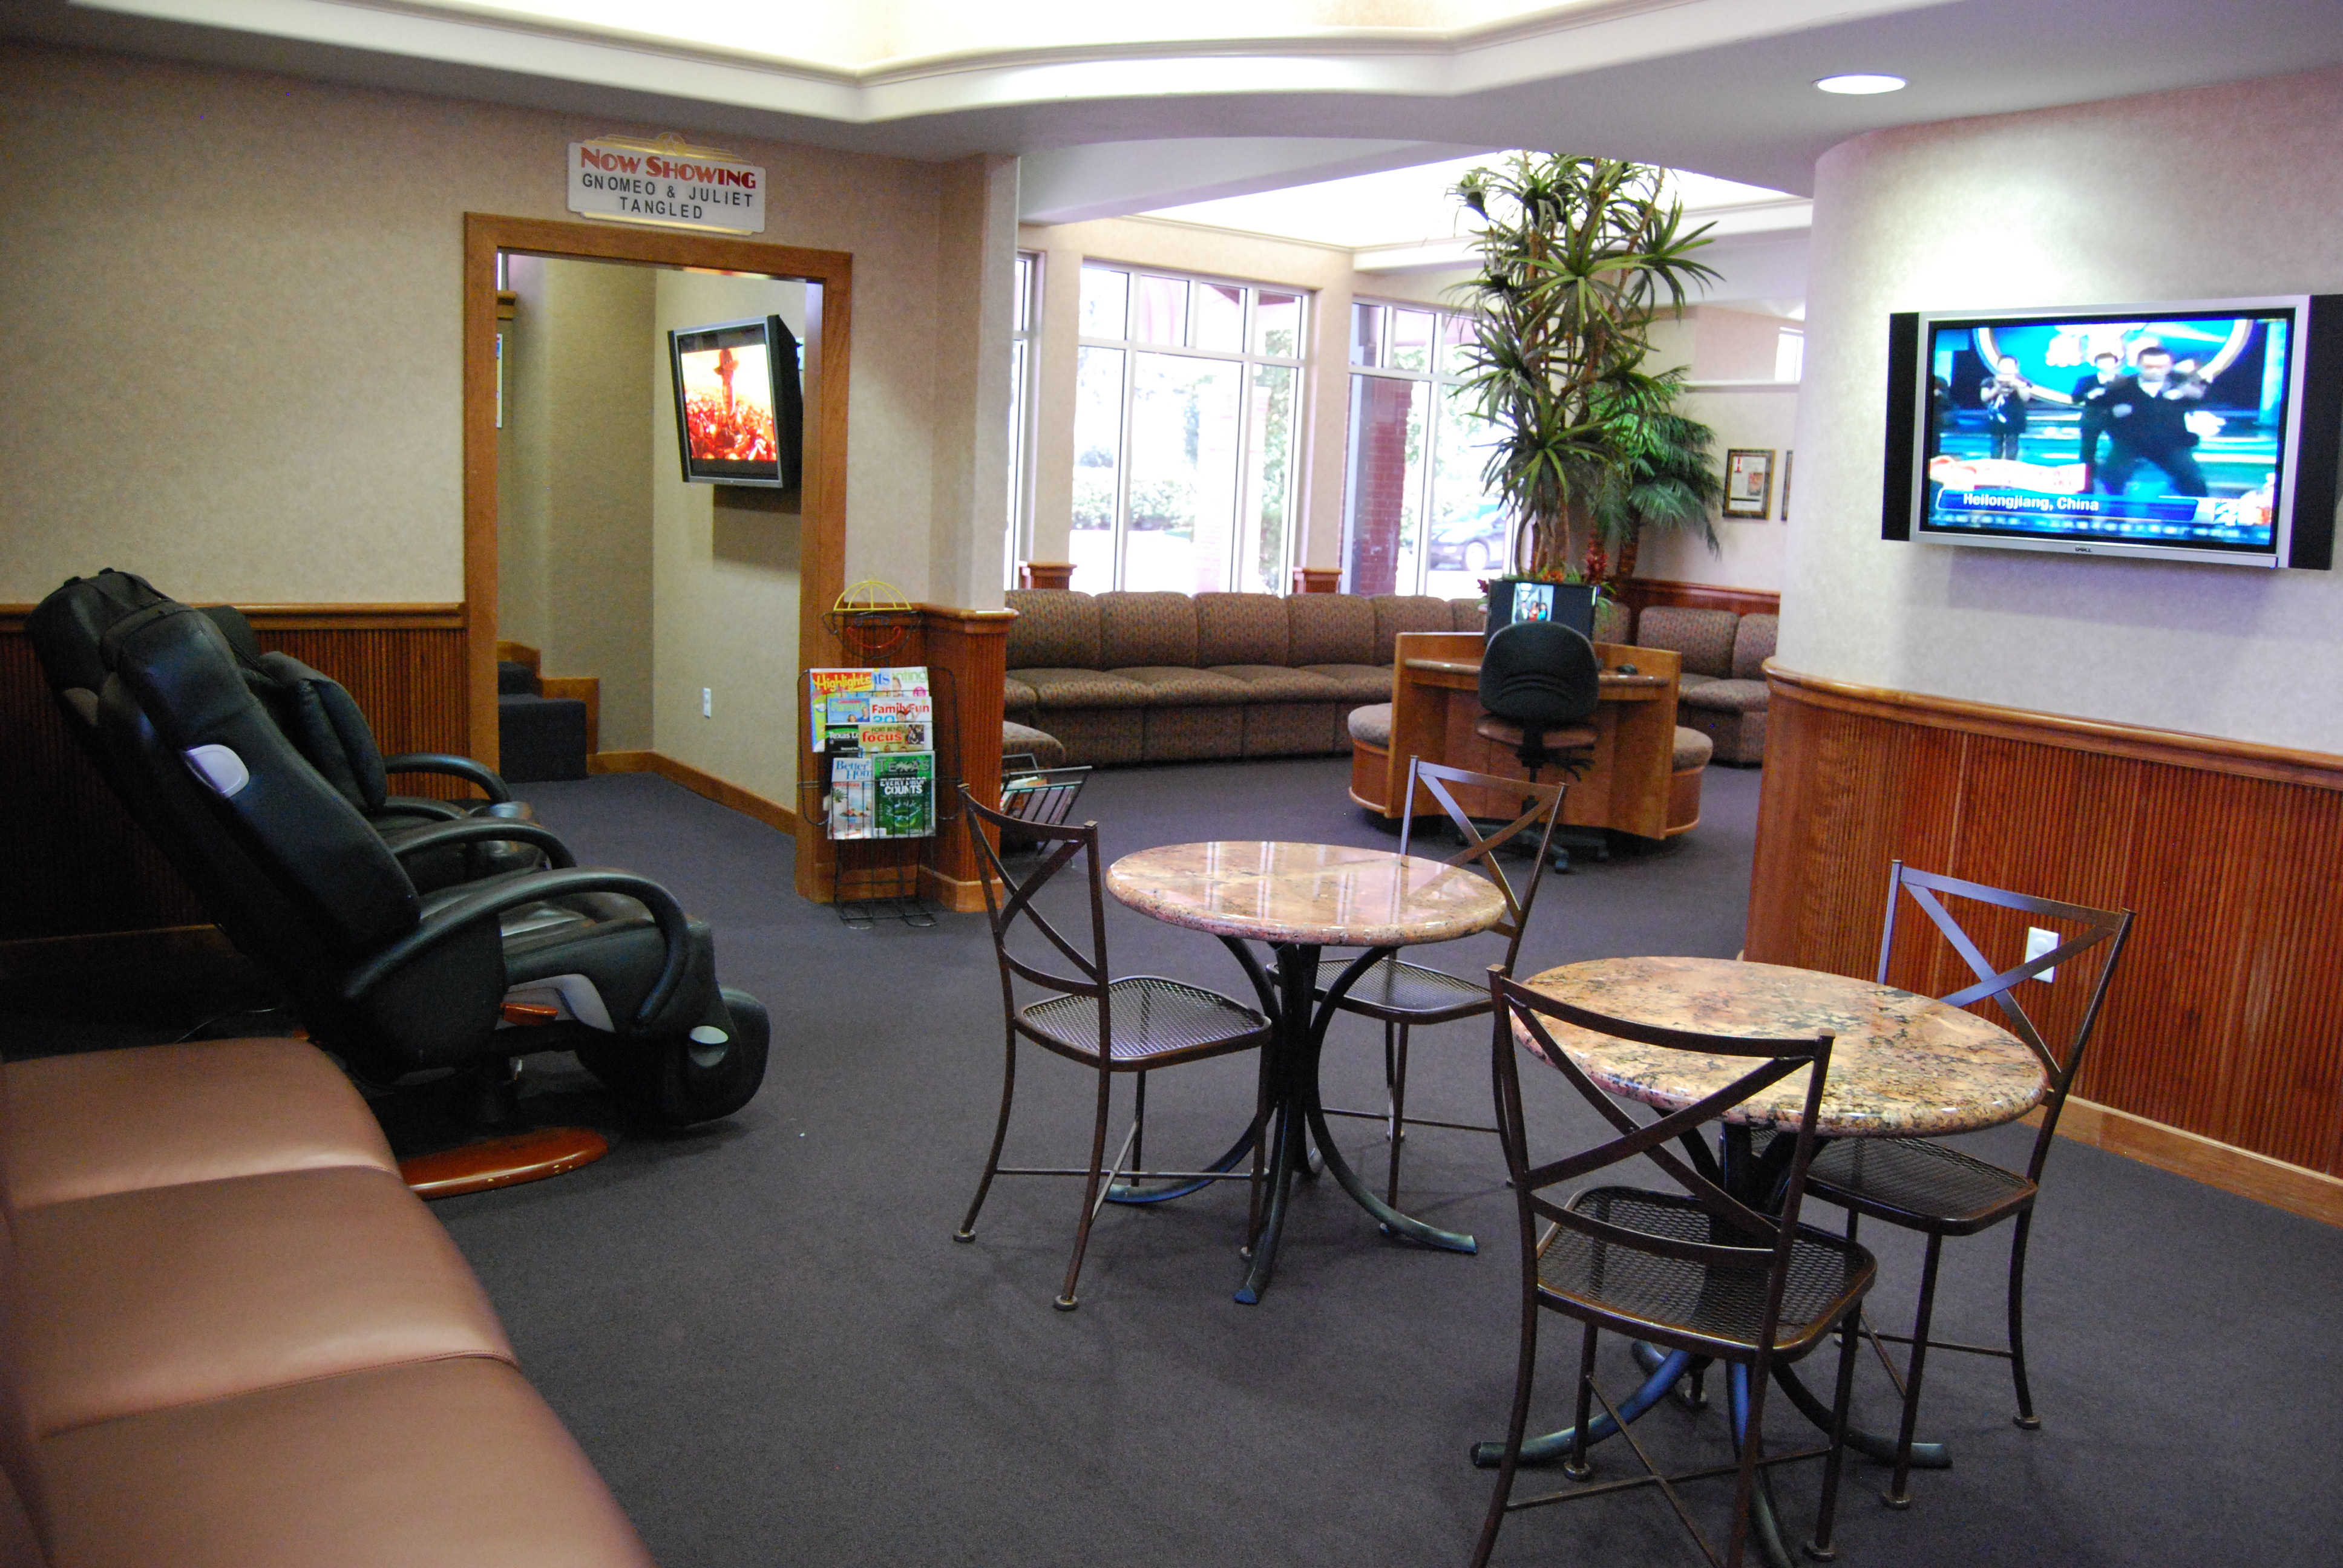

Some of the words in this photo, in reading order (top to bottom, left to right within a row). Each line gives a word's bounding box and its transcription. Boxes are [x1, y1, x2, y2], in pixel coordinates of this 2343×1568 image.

[646, 155, 756, 189] SHOWING
[582, 173, 656, 195] GNOMEO
[667, 185, 675, 198] &
[689, 186, 753, 207] JULIET
[620, 197, 703, 219] TANGLED
[1963, 493, 2054, 511] Heilongjiang,
[2057, 497, 2099, 511] China
[813, 673, 872, 691] Highlights
[862, 731, 903, 743] focus
[836, 760, 868, 770] Better
[884, 785, 923, 795] COUNTS
